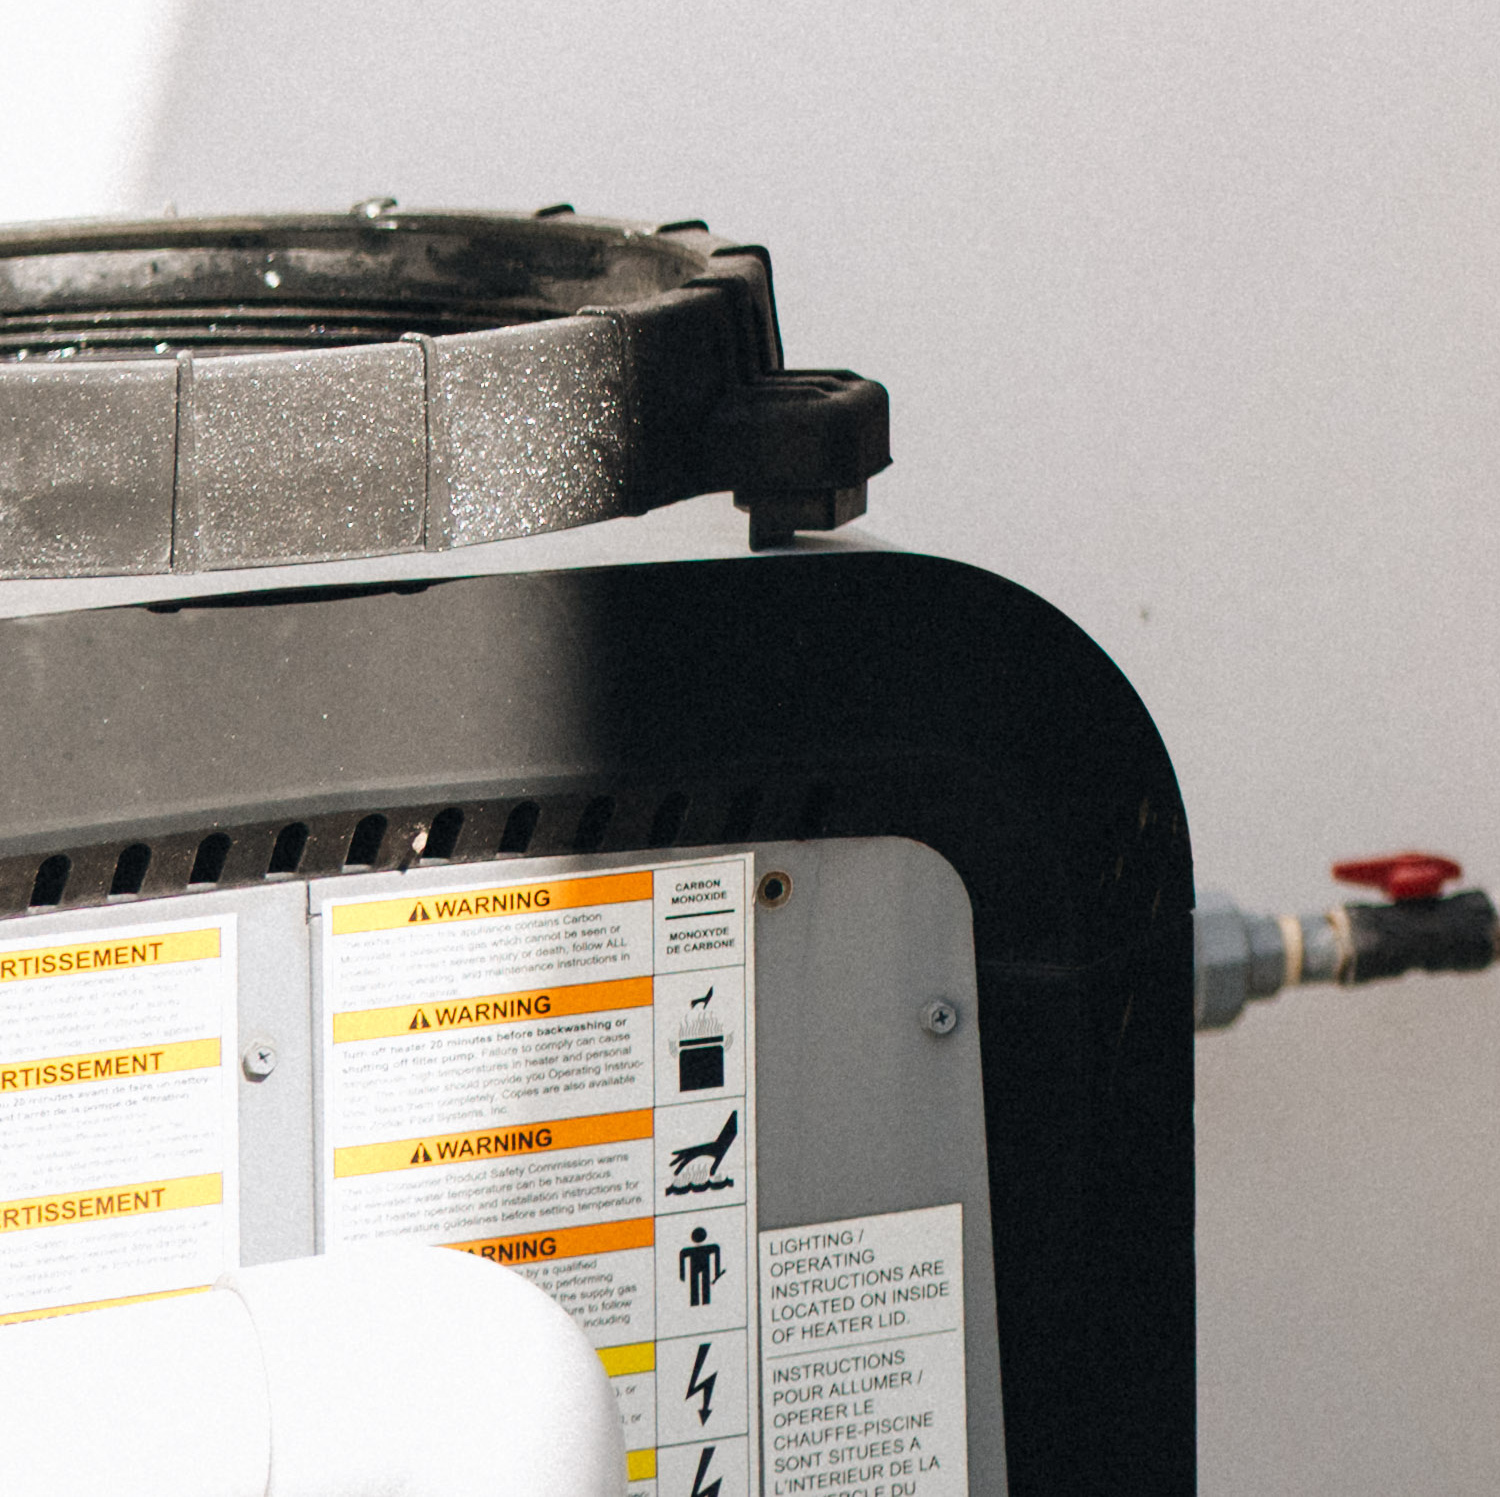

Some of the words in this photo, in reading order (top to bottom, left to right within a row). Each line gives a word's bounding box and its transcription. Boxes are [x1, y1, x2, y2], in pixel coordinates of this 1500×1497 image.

[675, 879, 721, 892] CARBON
[435, 889, 550, 918] WARNING
[671, 891, 727, 905] MONOXIDE
[562, 912, 602, 925] Carbon
[524, 930, 560, 943] cannot
[669, 926, 729, 941] MONOXYDE
[572, 941, 602, 953] follow
[666, 945, 680, 955] DE
[683, 938, 736, 953] CARBONE
[436, 995, 551, 1026] WARNING
[496, 1030, 532, 1041] before
[536, 1020, 612, 1037] backwashing
[614, 1019, 626, 1028] or
[534, 1038, 572, 1051] comply
[574, 1037, 596, 1047] can
[598, 1033, 630, 1044] cause
[524, 1054, 558, 1067] heater
[562, 1050, 582, 1062] and
[584, 1045, 632, 1061] personal
[546, 1064, 600, 1080] Operating
[542, 1084, 560, 1094] are
[562, 1080, 586, 1091] also
[588, 1074, 636, 1088] available
[437, 1128, 552, 1159] WARNING
[526, 1157, 594, 1173] Commission
[596, 1153, 630, 1165] warns
[500, 1191, 558, 1206] installation
[560, 1183, 622, 1199] instructions
[624, 1180, 640, 1190] for
[516, 1180, 536, 1189] can
[538, 1176, 552, 1187] be
[500, 1209, 536, 1221] before
[460, 1237, 557, 1264] RNING
[770, 1230, 853, 1256] LIGHTING
[552, 1258, 598, 1275] qualified
[770, 1249, 875, 1278] OPERATING
[556, 1272, 614, 1290] performing
[771, 1267, 904, 1300] INSTRUCTIONS
[908, 1260, 945, 1279] ARE
[580, 1286, 616, 1300] supply
[618, 1284, 638, 1296] gas
[772, 1296, 855, 1322] LOCATED
[860, 1291, 886, 1309] ON
[892, 1281, 950, 1304] INSIDE
[600, 1298, 634, 1310] follow
[772, 1327, 795, 1344] OF
[801, 1316, 873, 1340] HEATER
[772, 1349, 905, 1384] INSTRUCTIONS
[773, 1384, 823, 1406] POUR
[828, 1371, 913, 1398] ALLUMER
[773, 1402, 848, 1429] OPERER
[853, 1399, 874, 1416] LE
[773, 1411, 934, 1451] CHAUFFE-PISCINE
[774, 1450, 821, 1473] SONT
[829, 1438, 904, 1465] SITUEES
[910, 1436, 922, 1451] A
[775, 1463, 884, 1496] L'INTERIEUR
[890, 1457, 913, 1476] DE
[919, 1456, 940, 1472] LA
[891, 1481, 917, 1497] DU
